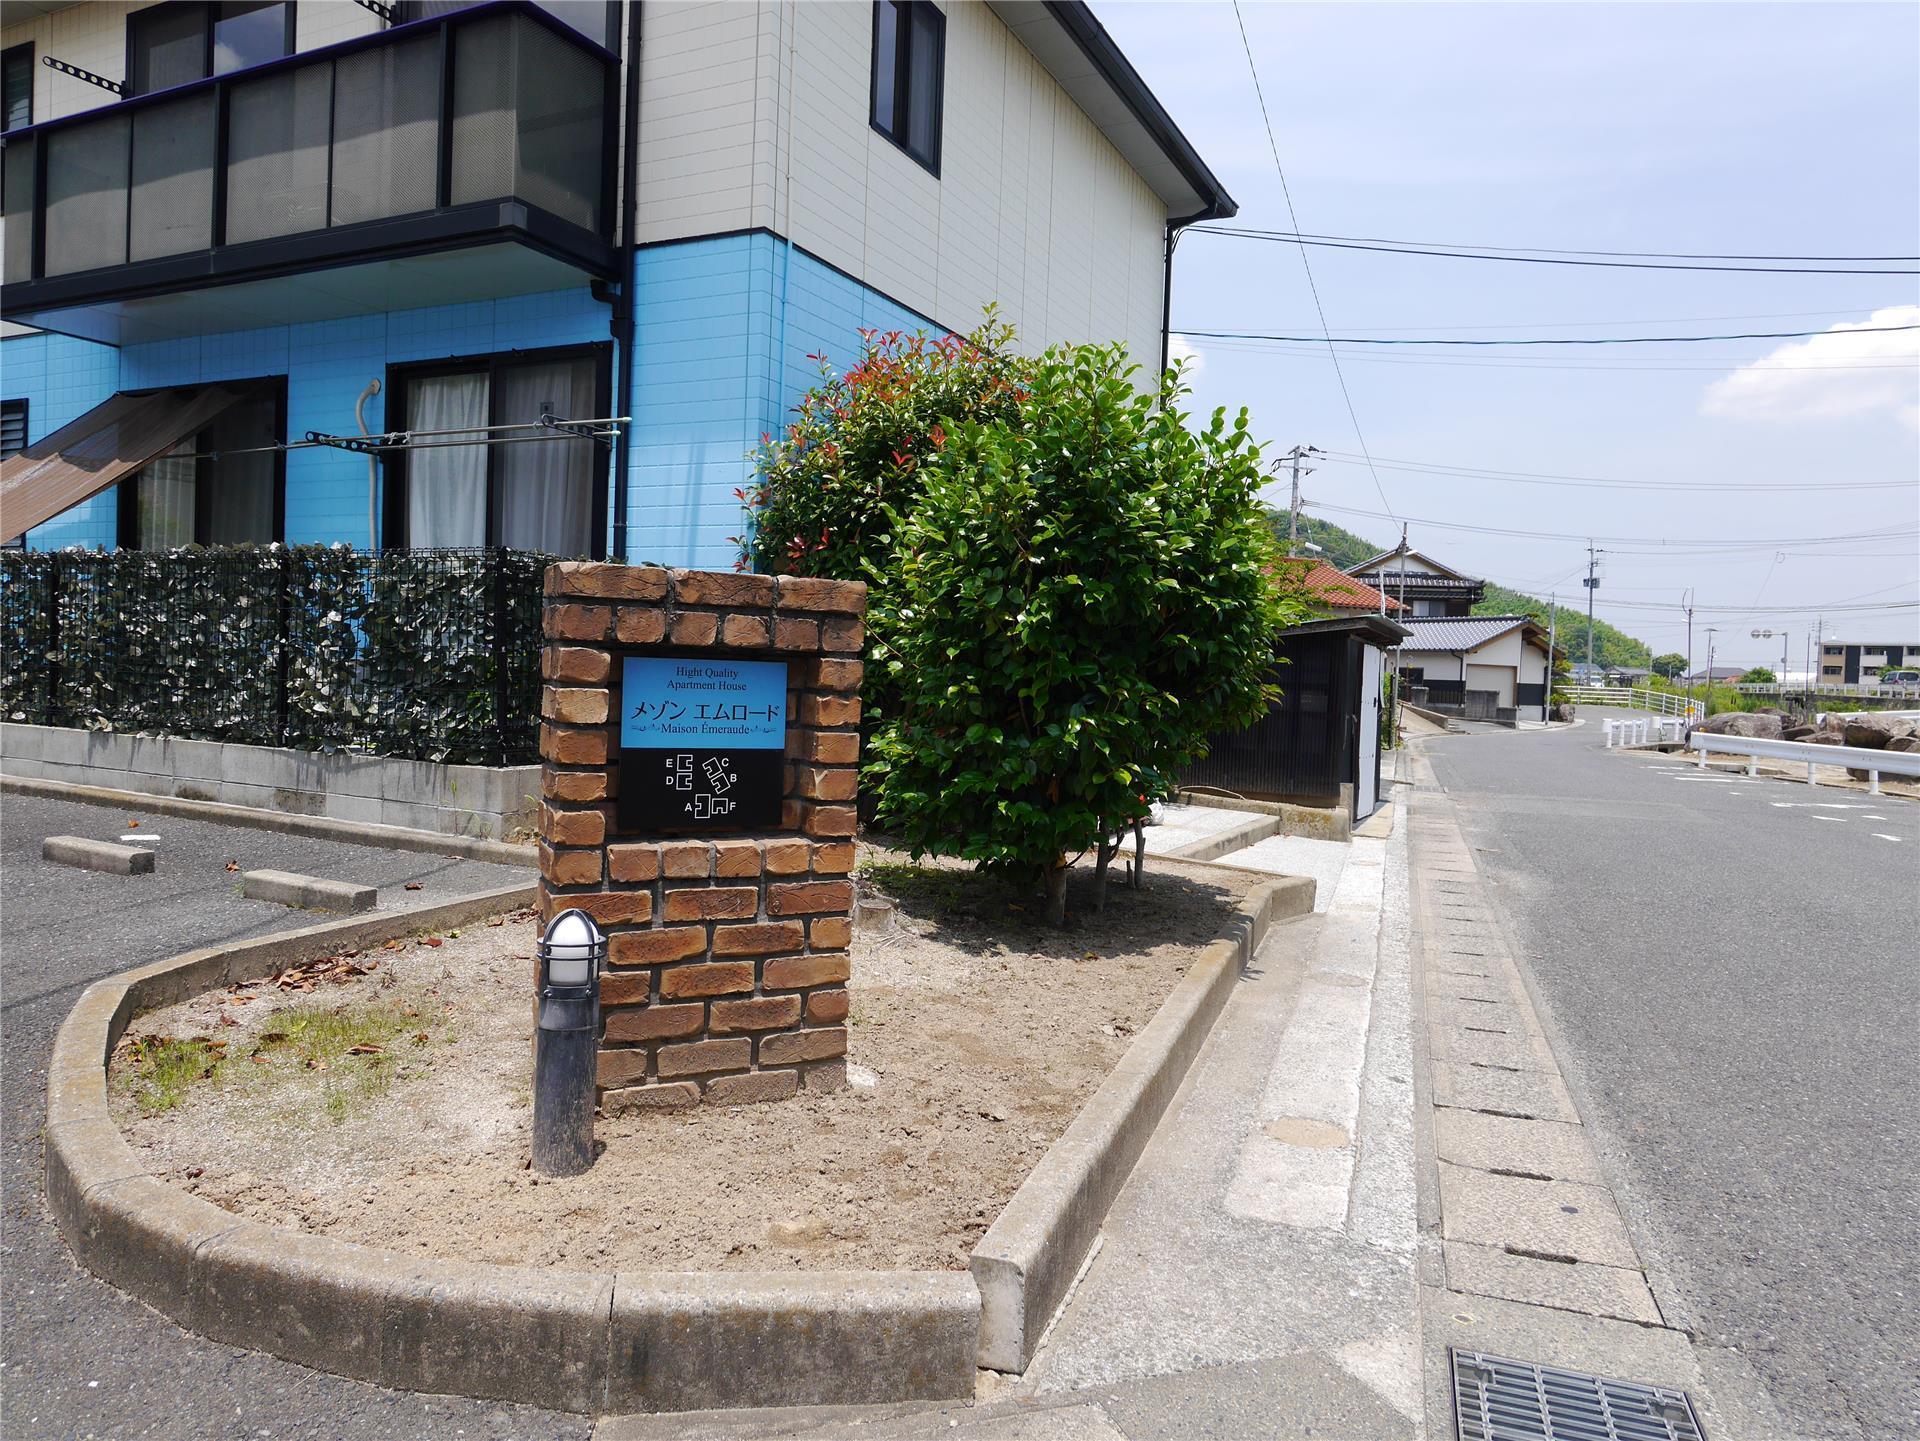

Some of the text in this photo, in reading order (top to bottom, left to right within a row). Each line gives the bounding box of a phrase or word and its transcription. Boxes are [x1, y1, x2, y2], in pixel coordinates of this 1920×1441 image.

[676, 666, 739, 681] Hight Quality
[666, 680, 747, 691] Apartment House
[630, 700, 780, 722] メゾン エムロード
[661, 721, 750, 735] Maison Émeraude
[665, 759, 673, 768] E
[721, 758, 729, 767] C
[665, 776, 674, 785] D
[730, 774, 737, 783] B
[684, 803, 693, 812] A
[729, 802, 737, 811] F
